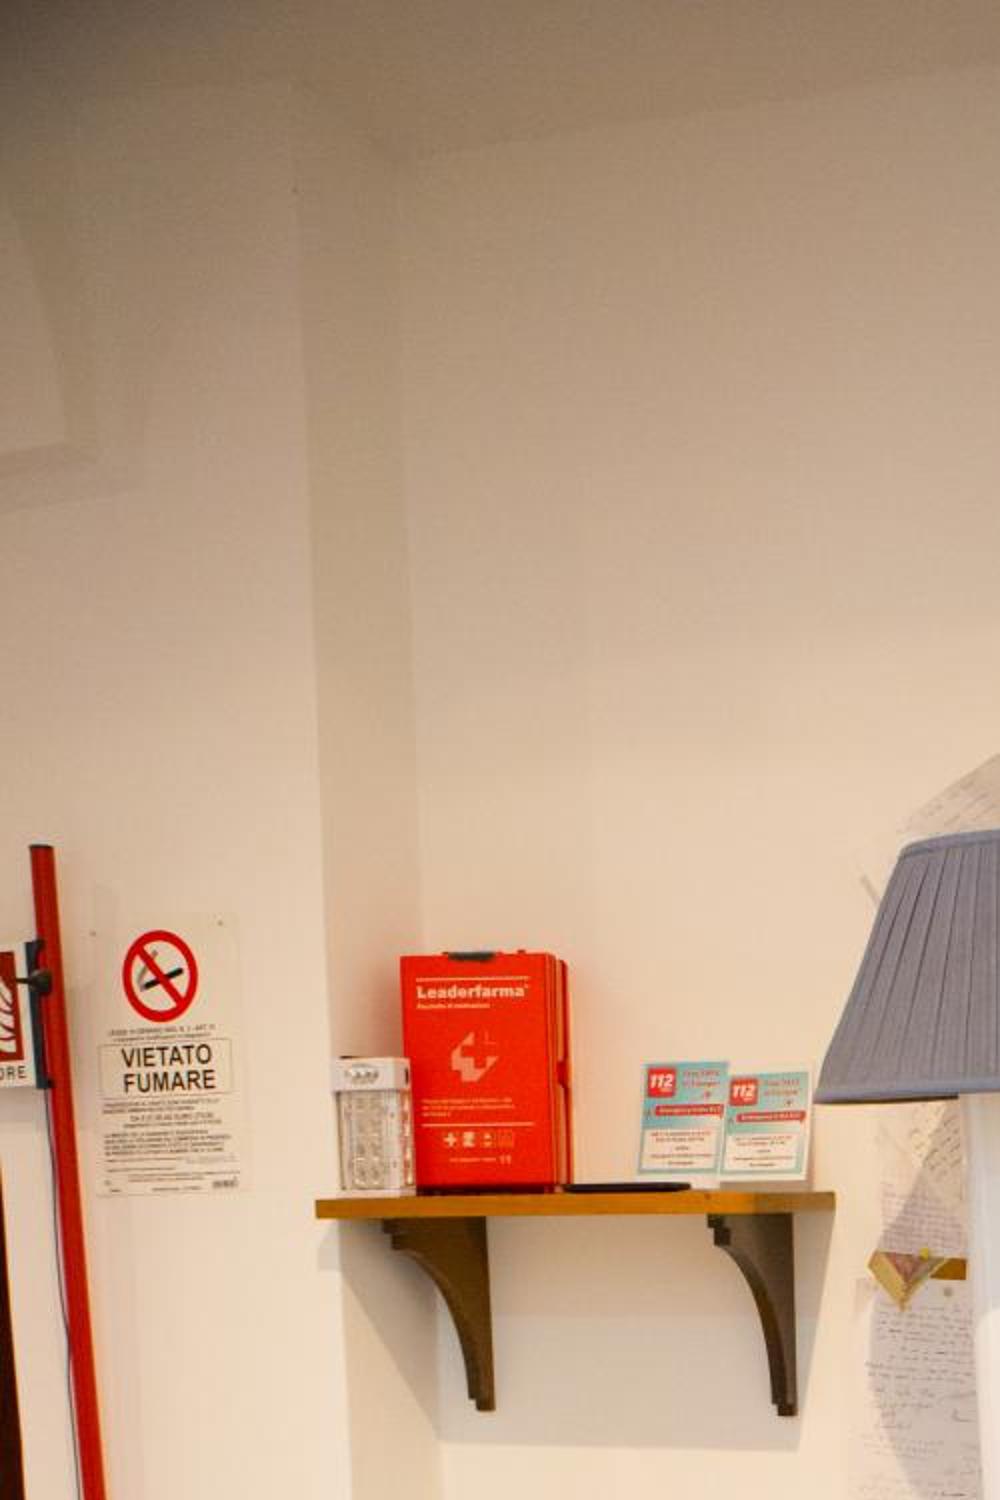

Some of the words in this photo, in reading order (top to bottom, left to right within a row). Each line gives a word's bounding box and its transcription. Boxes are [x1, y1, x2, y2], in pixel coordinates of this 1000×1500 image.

[416, 984, 525, 999] Leaderfarma
[121, 1044, 213, 1068] VIETATO
[123, 1069, 216, 1093] FUMARE
[649, 1073, 674, 1089] 112
[731, 1084, 756, 1098] 112
